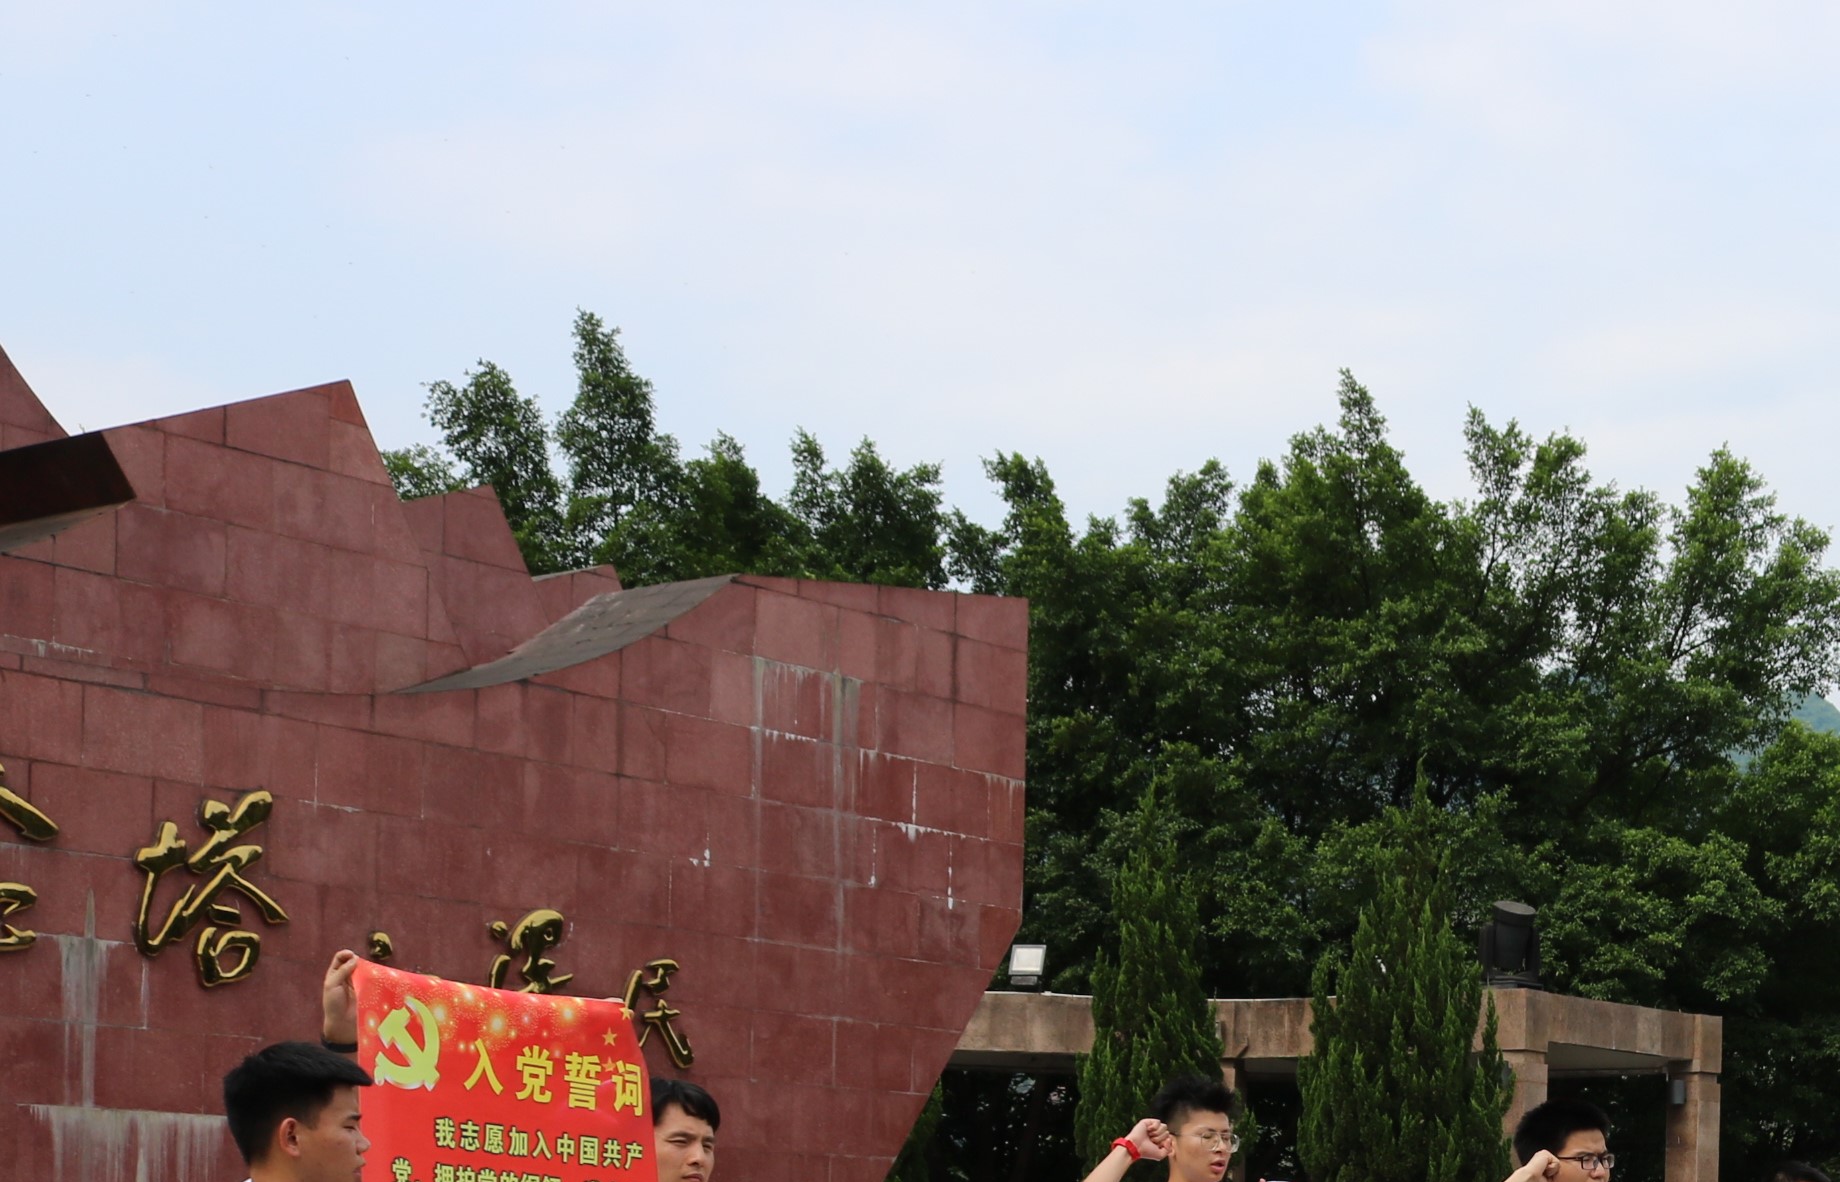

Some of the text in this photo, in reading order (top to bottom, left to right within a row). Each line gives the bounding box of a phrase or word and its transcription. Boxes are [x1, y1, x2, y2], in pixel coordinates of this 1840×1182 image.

[463, 1037, 644, 1117] 入党誓词
[434, 1116, 643, 1170] 我志愿加入中国共产
